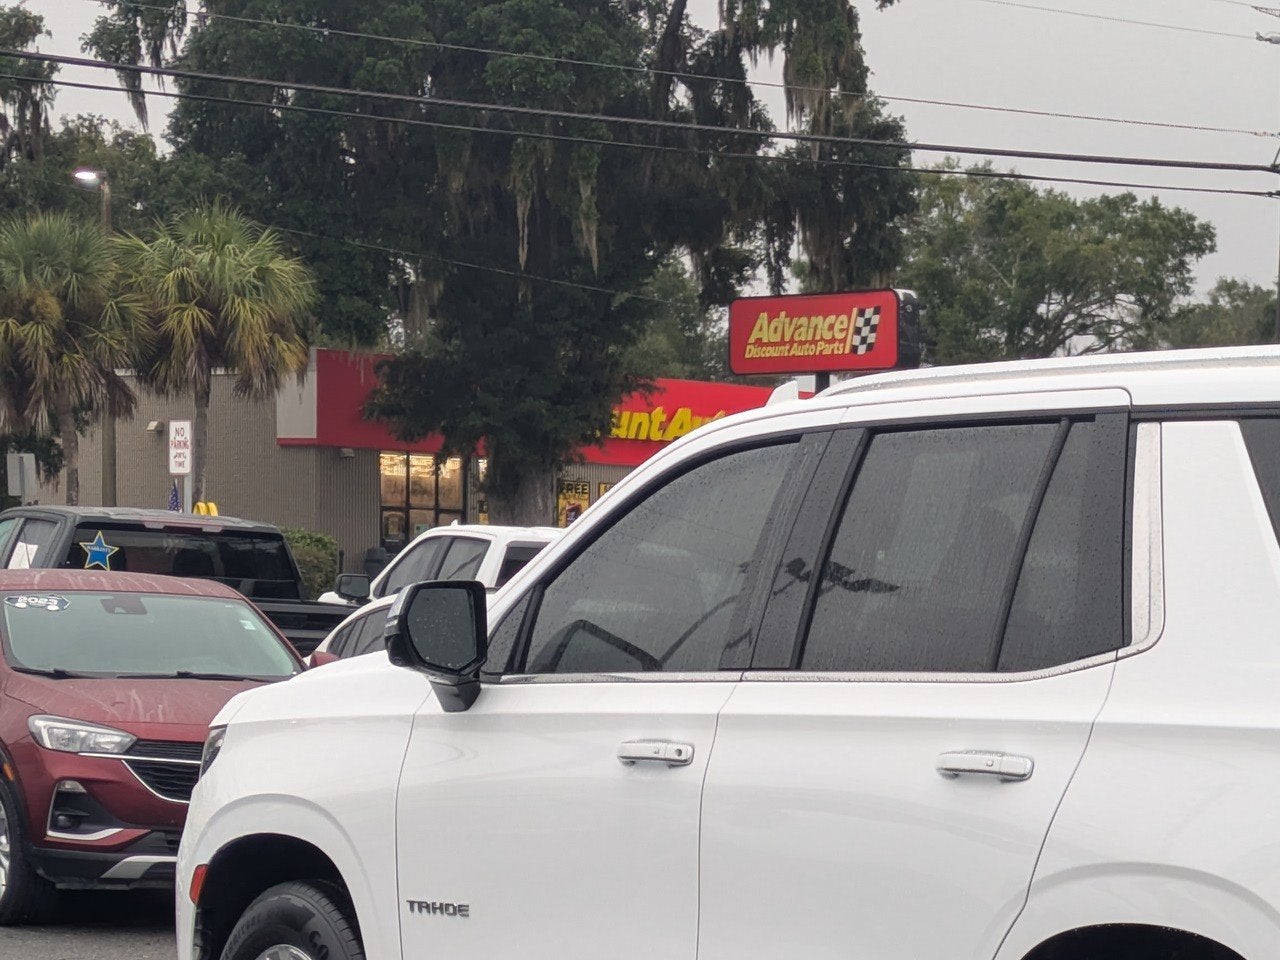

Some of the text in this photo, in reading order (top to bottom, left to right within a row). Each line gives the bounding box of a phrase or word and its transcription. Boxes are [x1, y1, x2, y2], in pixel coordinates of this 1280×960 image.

[747, 310, 849, 344] Advance
[744, 341, 844, 358] Discount Auto Parts
[175, 427, 185, 437] NO
[170, 439, 189, 449] PARKING
[17, 595, 58, 605] 2023
[406, 899, 470, 917] TAHOE
